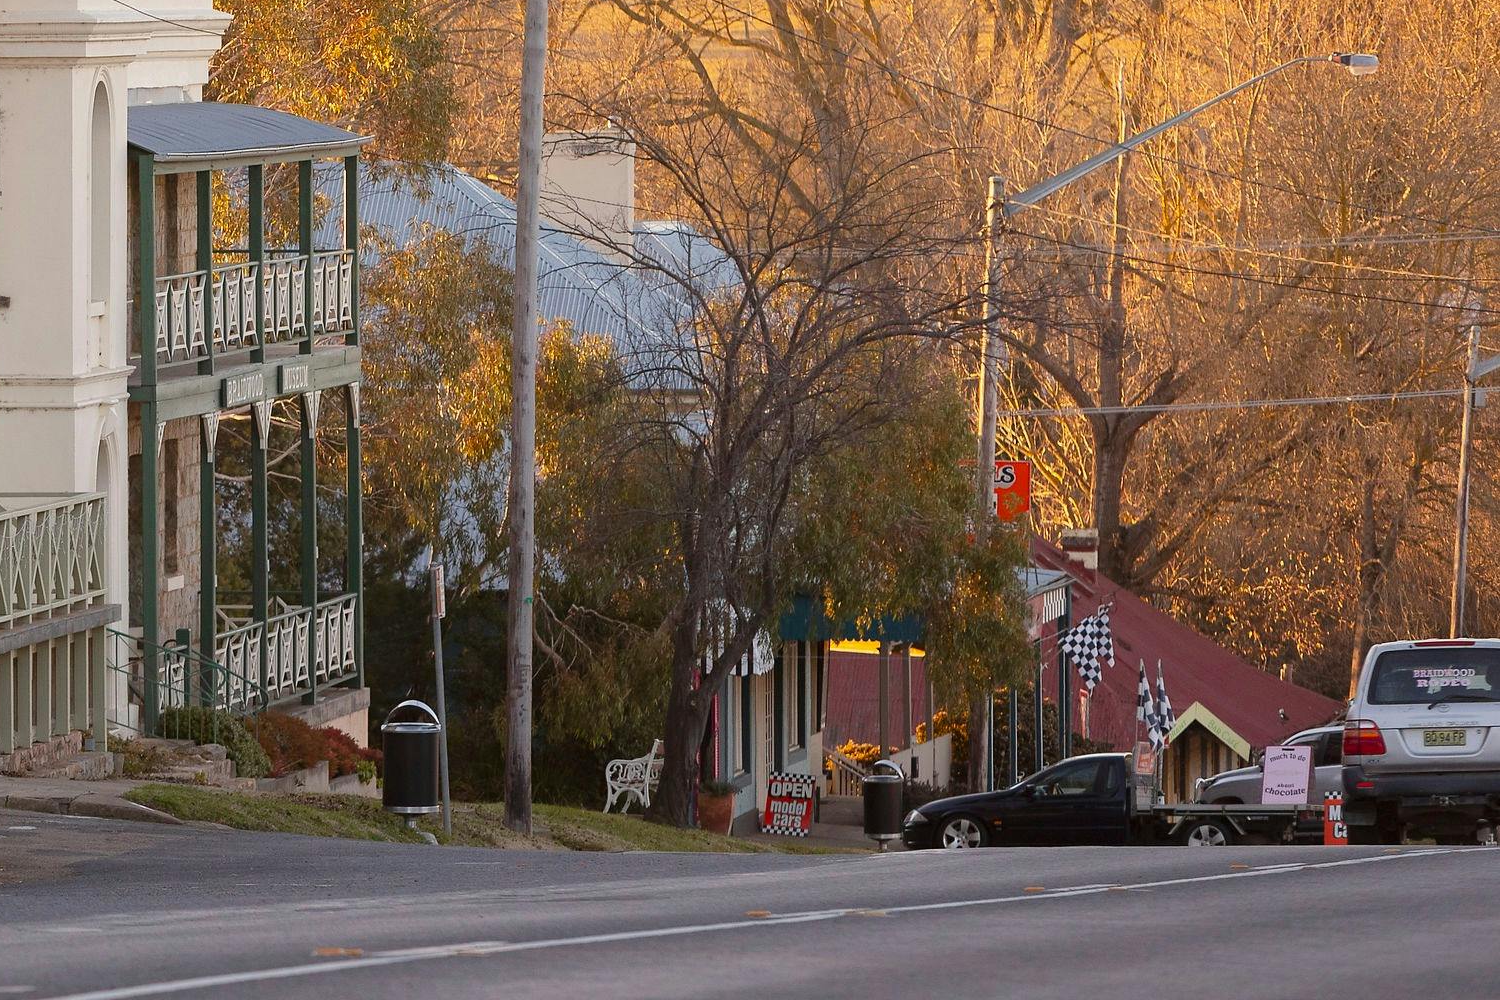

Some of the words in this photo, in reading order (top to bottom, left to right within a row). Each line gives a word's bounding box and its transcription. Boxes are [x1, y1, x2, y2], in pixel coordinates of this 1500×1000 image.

[284, 365, 309, 390] MUSEUM
[1413, 668, 1475, 678] BRAIDWOOD
[1417, 679, 1470, 688] RODEO
[1270, 753, 1288, 762] much
[771, 782, 813, 798] OPEN
[1265, 787, 1306, 796] chocolate
[770, 800, 807, 816] model
[773, 814, 802, 828] cars
